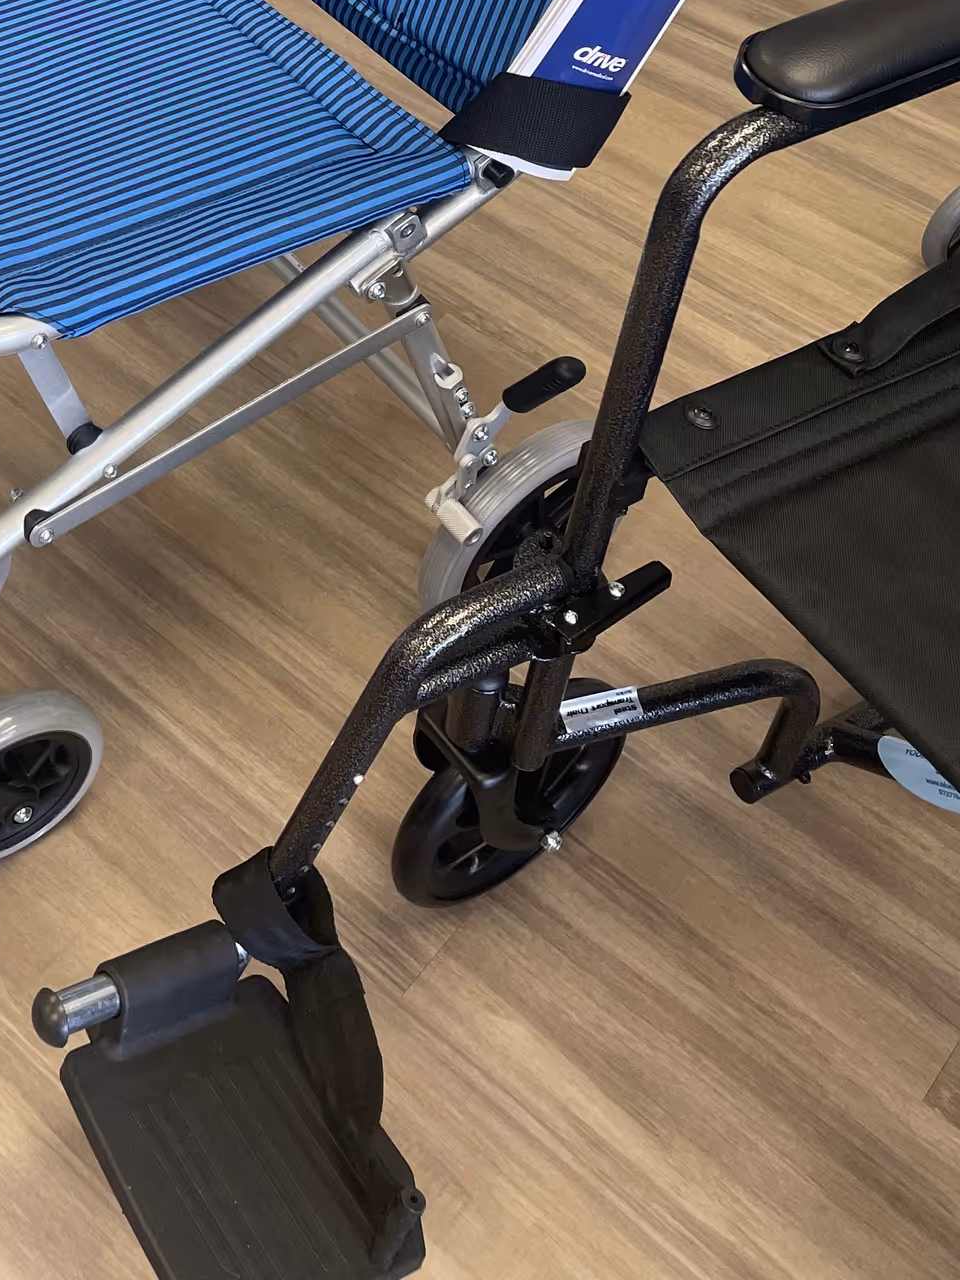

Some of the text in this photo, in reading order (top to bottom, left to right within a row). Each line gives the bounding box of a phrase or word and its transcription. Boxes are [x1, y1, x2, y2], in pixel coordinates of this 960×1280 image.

[573, 45, 626, 73] drive
[567, 697, 634, 717] Transport Chair
